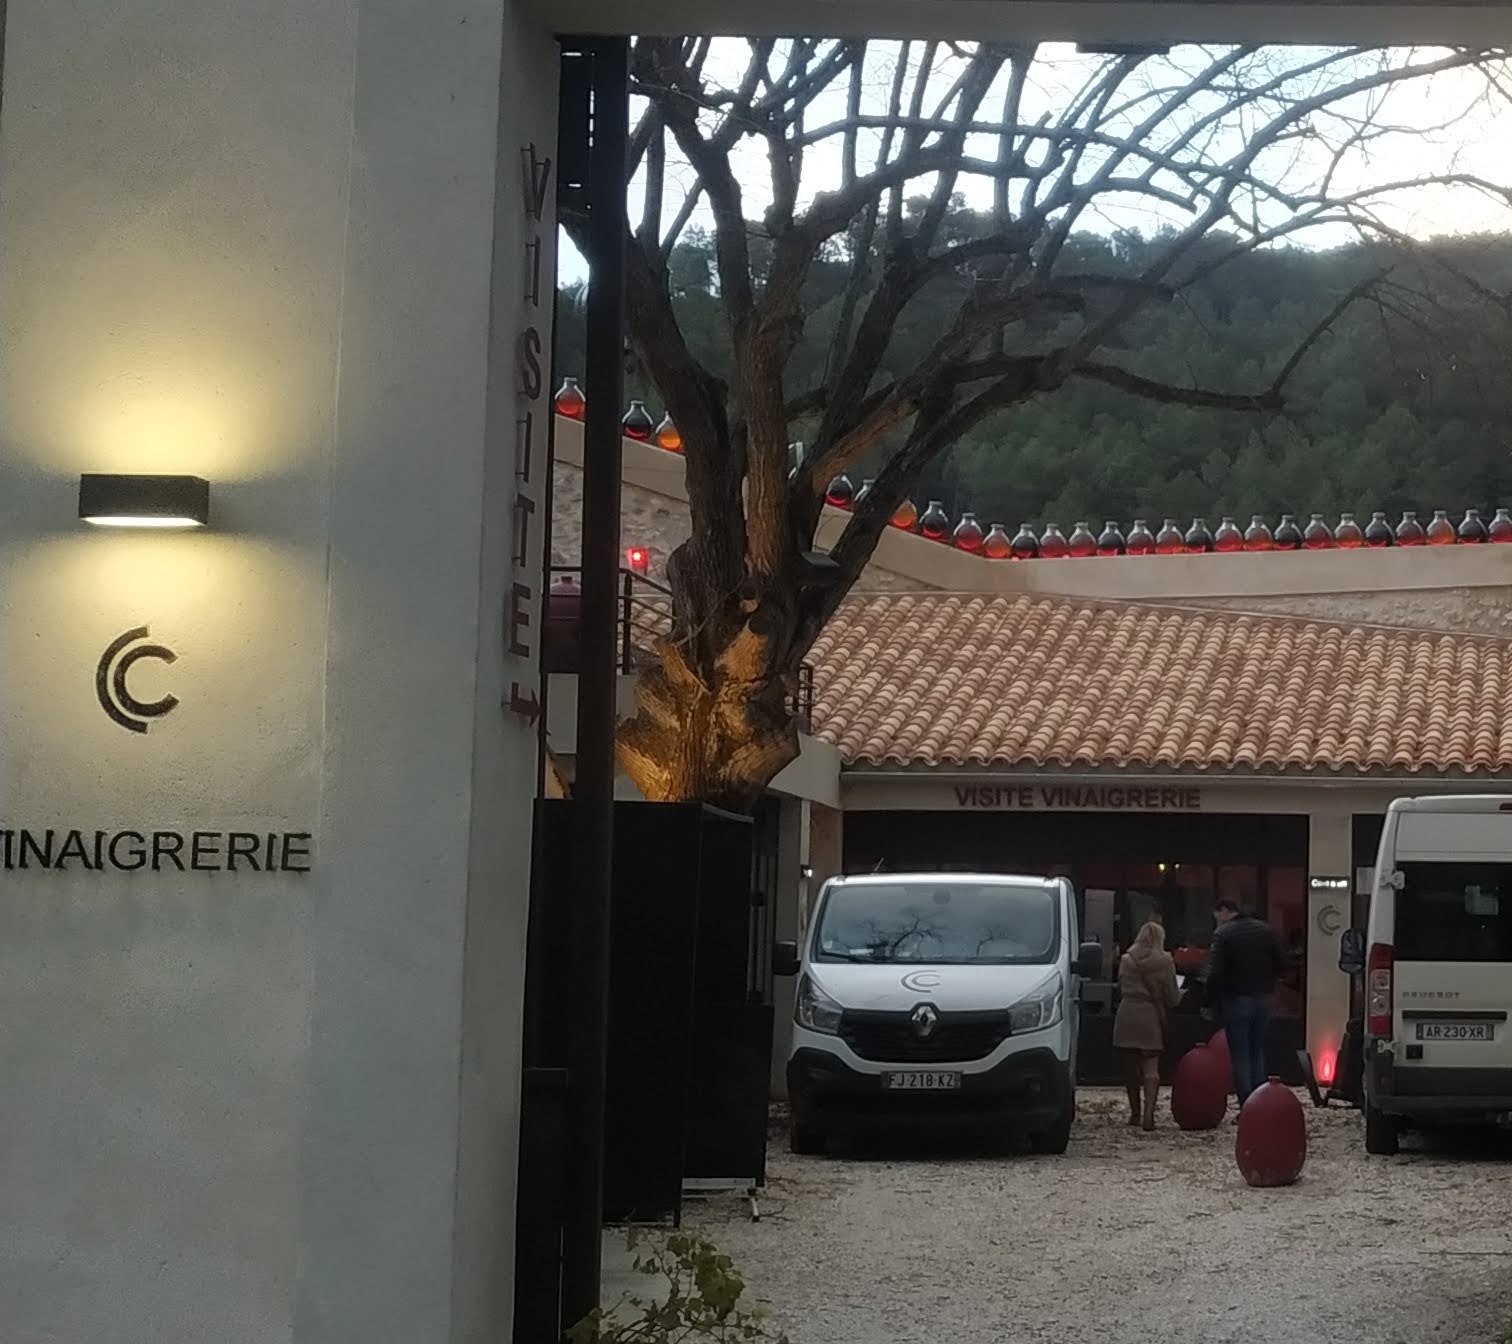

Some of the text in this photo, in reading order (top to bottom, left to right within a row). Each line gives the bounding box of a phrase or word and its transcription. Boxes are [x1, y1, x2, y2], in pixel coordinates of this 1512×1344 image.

[508, 142, 552, 658] VISITE
[953, 785, 1201, 808] VISITE VINAIGRERIE
[0, 829, 312, 872] INAIGRERIE
